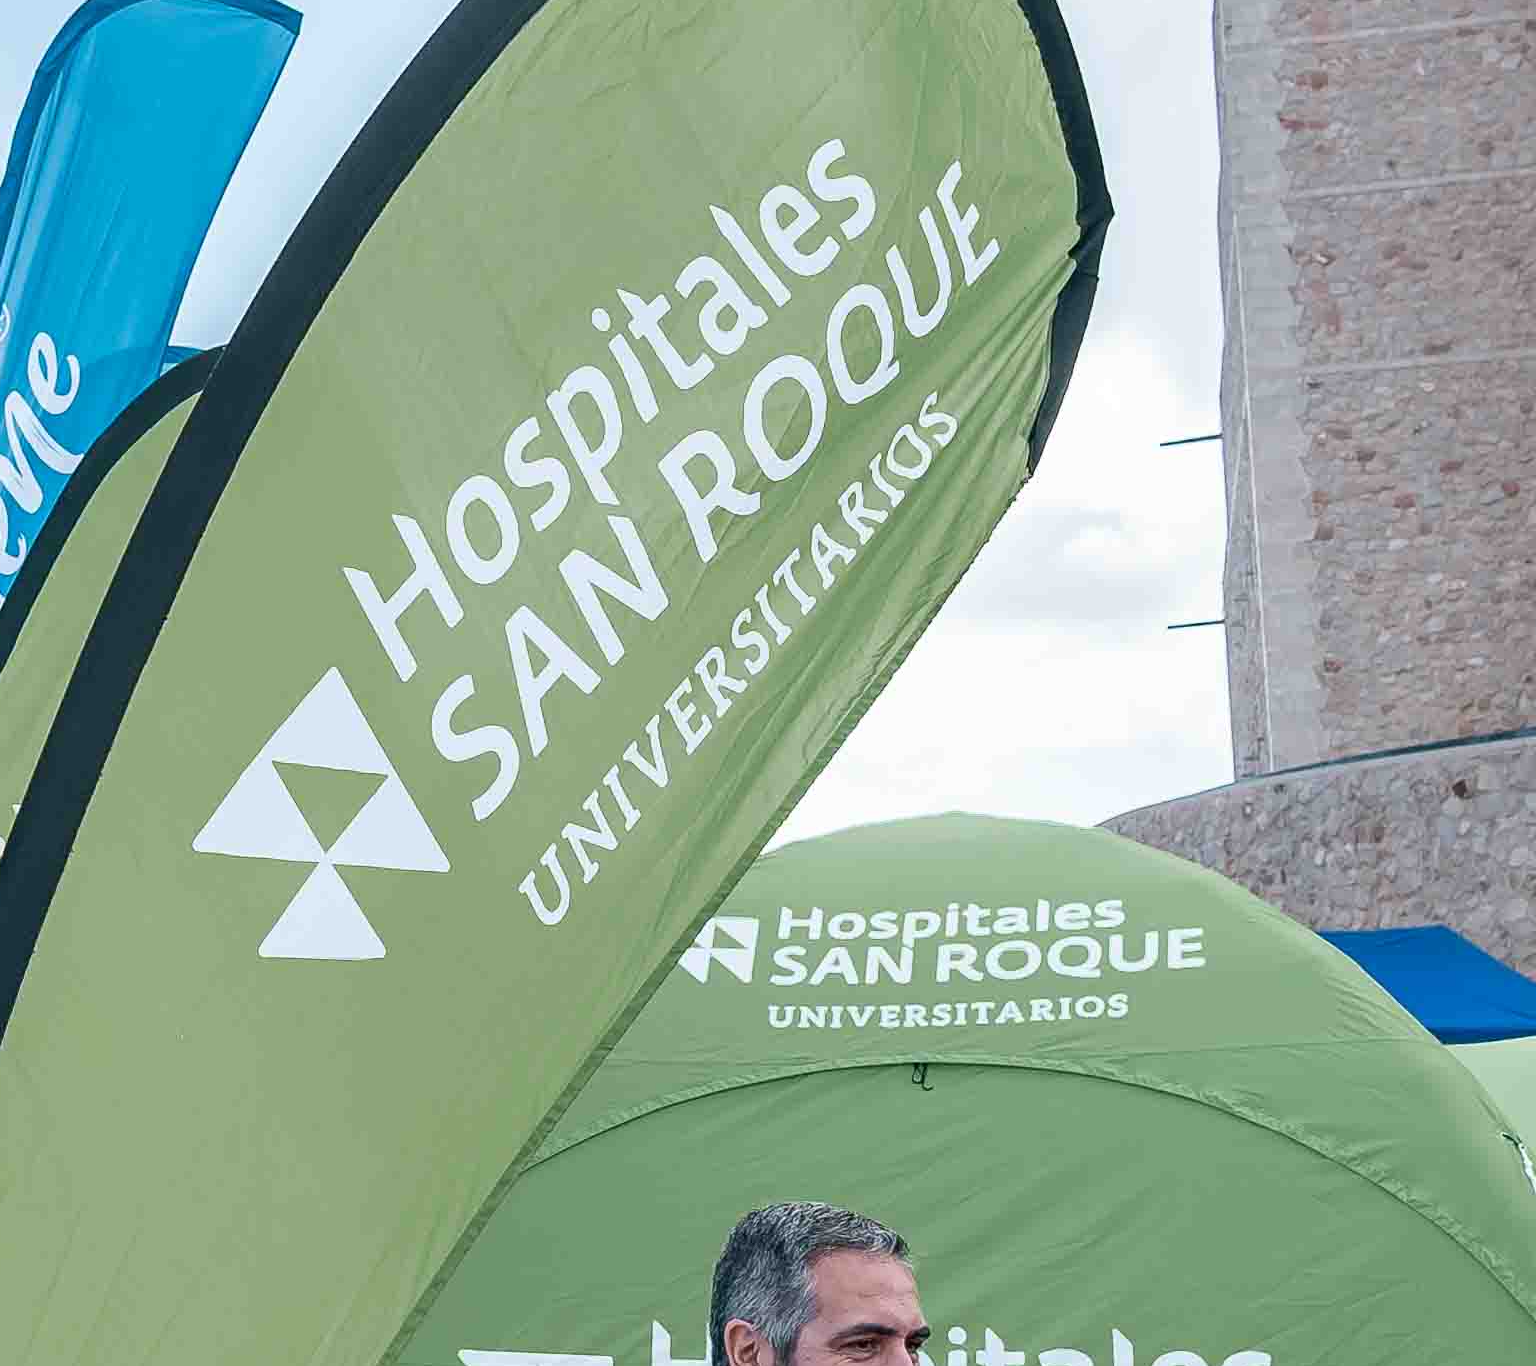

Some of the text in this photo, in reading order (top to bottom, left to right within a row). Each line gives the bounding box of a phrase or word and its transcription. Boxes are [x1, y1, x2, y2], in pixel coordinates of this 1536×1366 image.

[342, 138, 877, 682] Hospitales
[431, 160, 1000, 822] SAN ROQUE
[517, 391, 960, 926] UNIVERSITARIOS
[767, 993, 1129, 1030] UNIVERSITARIOS
[769, 926, 1206, 987] SAN ROQUE
[776, 898, 1126, 951] Hospitales
